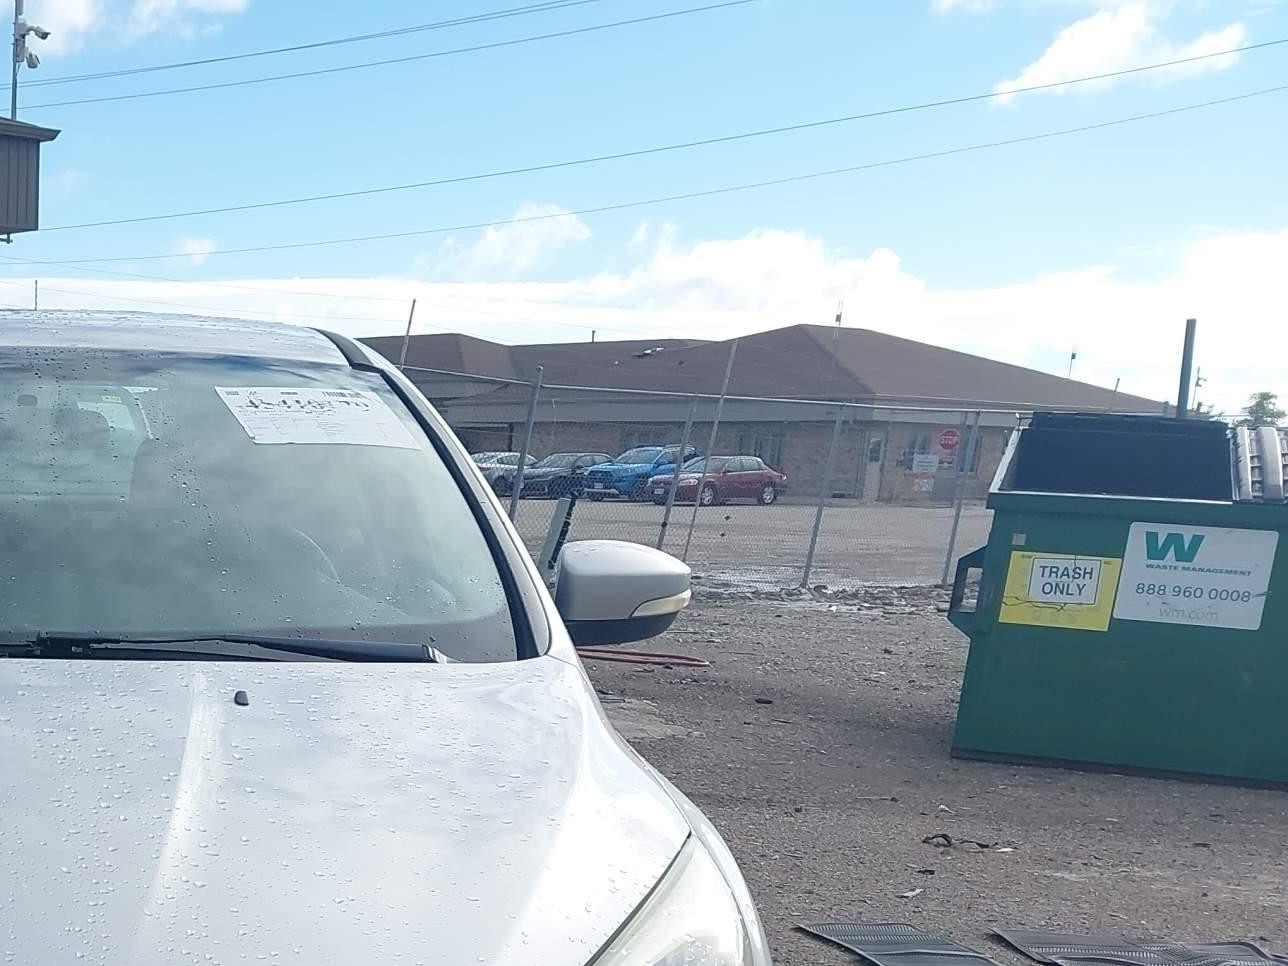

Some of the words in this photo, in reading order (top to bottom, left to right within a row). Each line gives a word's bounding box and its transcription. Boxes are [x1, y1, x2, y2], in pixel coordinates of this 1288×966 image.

[1039, 565, 1094, 580] TRASH
[1145, 563, 1179, 572] WASTE
[1181, 566, 1252, 577] MANAGEMENT
[1041, 582, 1087, 596] ONLY
[1135, 582, 1167, 597] 888
[1171, 585, 1204, 599] 960
[1208, 588, 1251, 603] 0008
[1159, 608, 1219, 622] wm.com
